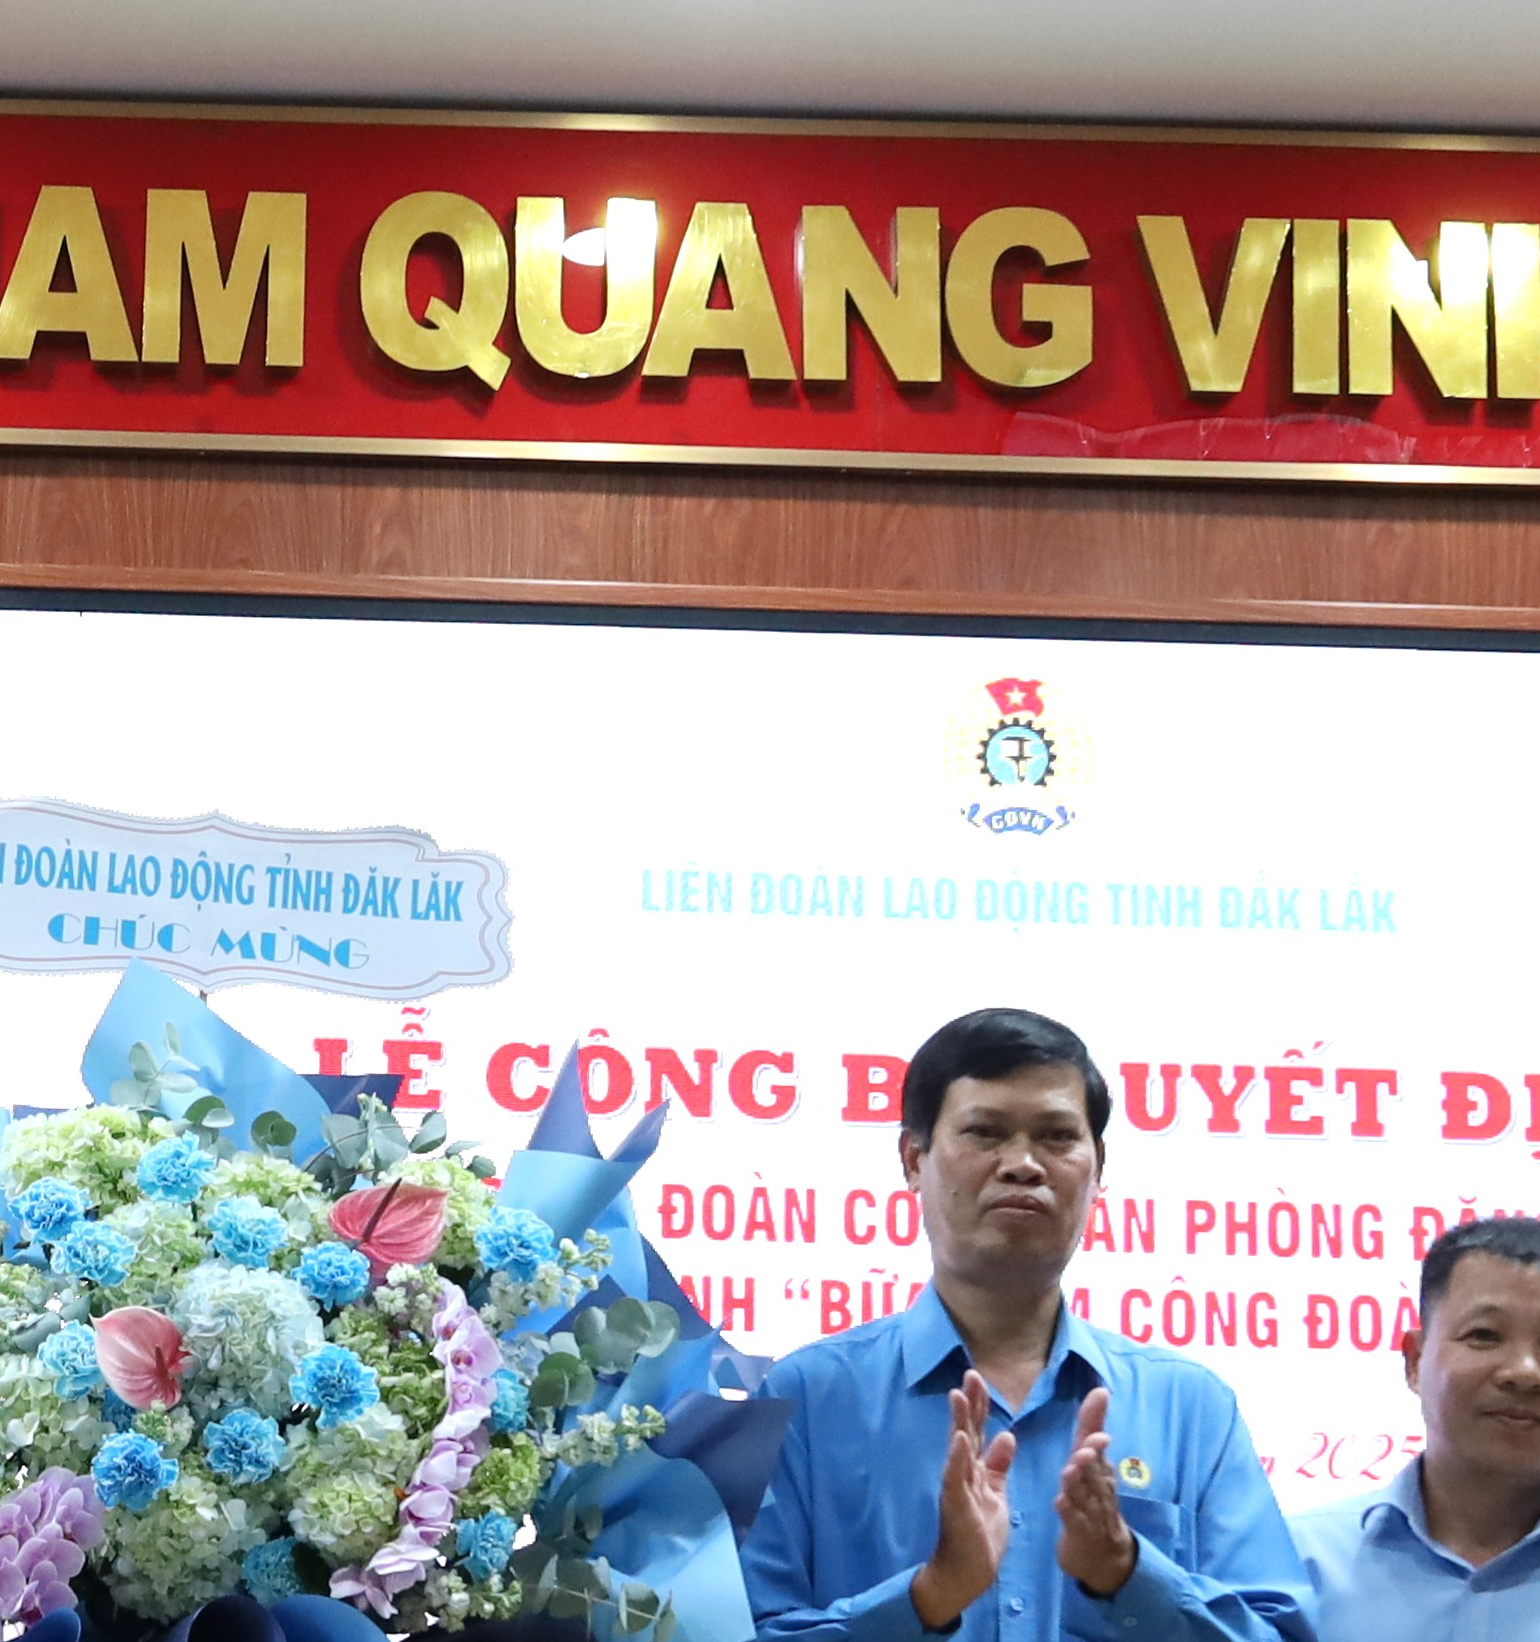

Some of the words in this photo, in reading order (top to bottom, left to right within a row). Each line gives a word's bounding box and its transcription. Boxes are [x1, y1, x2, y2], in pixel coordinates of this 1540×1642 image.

[359, 190, 1094, 391] QUANG
[13, 838, 98, 893] ĐOÀN
[107, 854, 163, 898] LAO
[169, 853, 256, 912] ĐỘNG
[265, 851, 333, 913] TỈNH
[641, 860, 734, 914] LIÊN
[750, 864, 865, 919] ĐOÀN
[883, 876, 959, 919] LAO
[975, 870, 1090, 933] ĐỘNG
[46, 911, 193, 953] CHÚC
[486, 1028, 795, 1119] CÔNG
[842, 1053, 911, 1123] B
[1120, 1041, 1398, 1139] UYẾT
[657, 1171, 817, 1244] ĐOÀN
[1082, 1186, 1155, 1254] ĂN
[1185, 1186, 1385, 1261] PHÒNG
[783, 1266, 925, 1335] “BỮ
[1121, 1275, 1279, 1349] CÔNG
[1304, 1282, 1422, 1352] ĐOÀ
